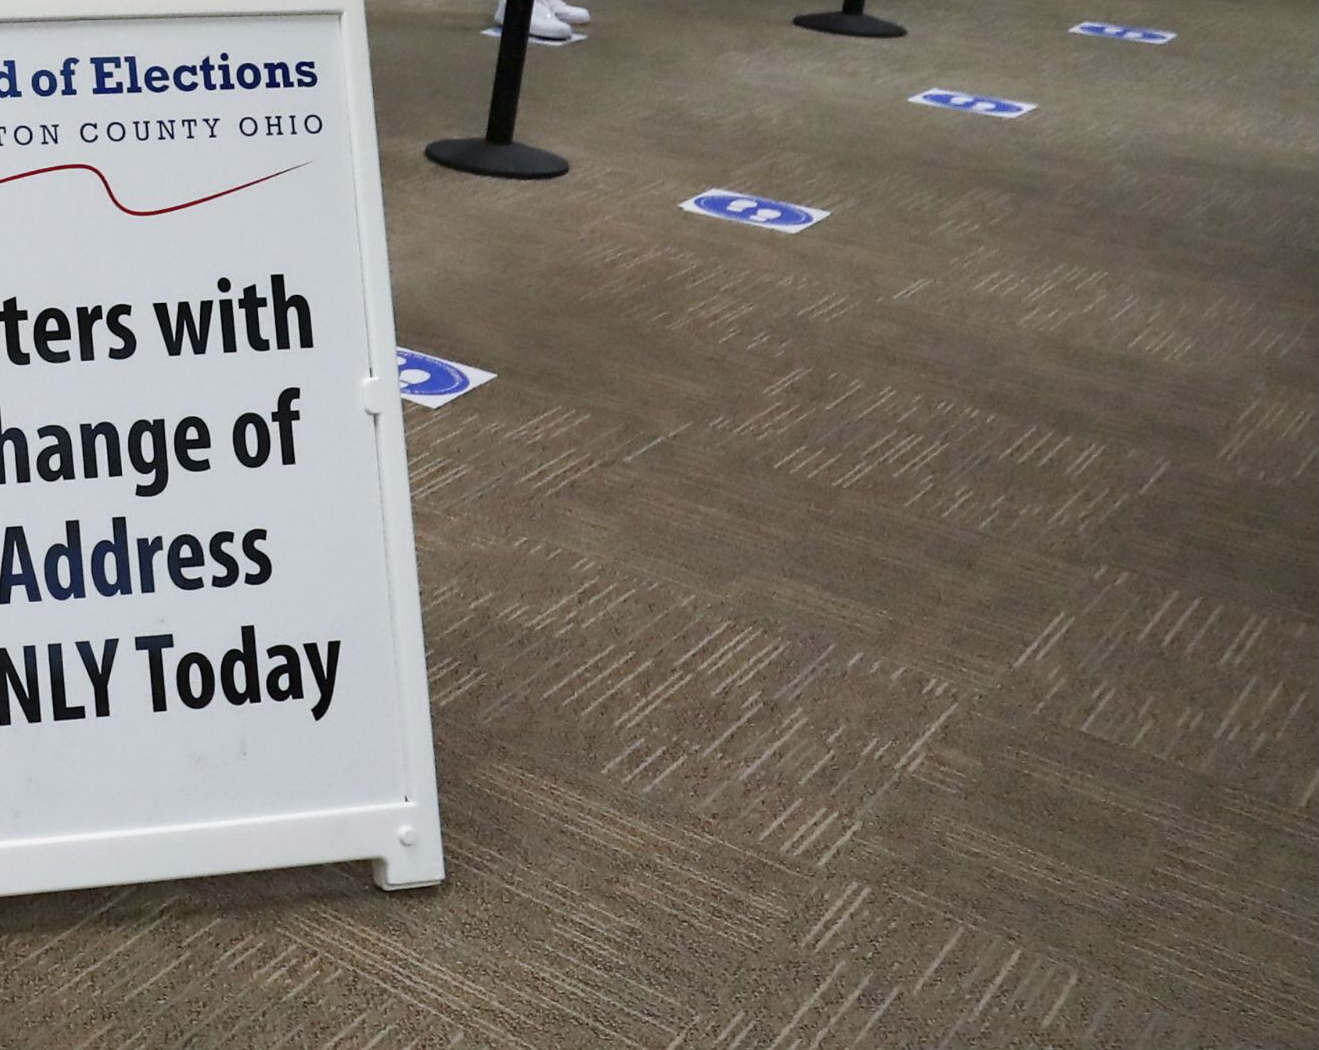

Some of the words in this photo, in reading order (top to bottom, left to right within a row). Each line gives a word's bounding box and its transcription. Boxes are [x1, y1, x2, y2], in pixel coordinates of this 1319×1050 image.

[31, 57, 80, 97] of
[90, 52, 318, 95] Elections
[79, 117, 221, 144] COUNTY
[239, 114, 324, 137] OHIO
[153, 274, 314, 357] with
[232, 387, 301, 468] of
[135, 625, 341, 721] Today
